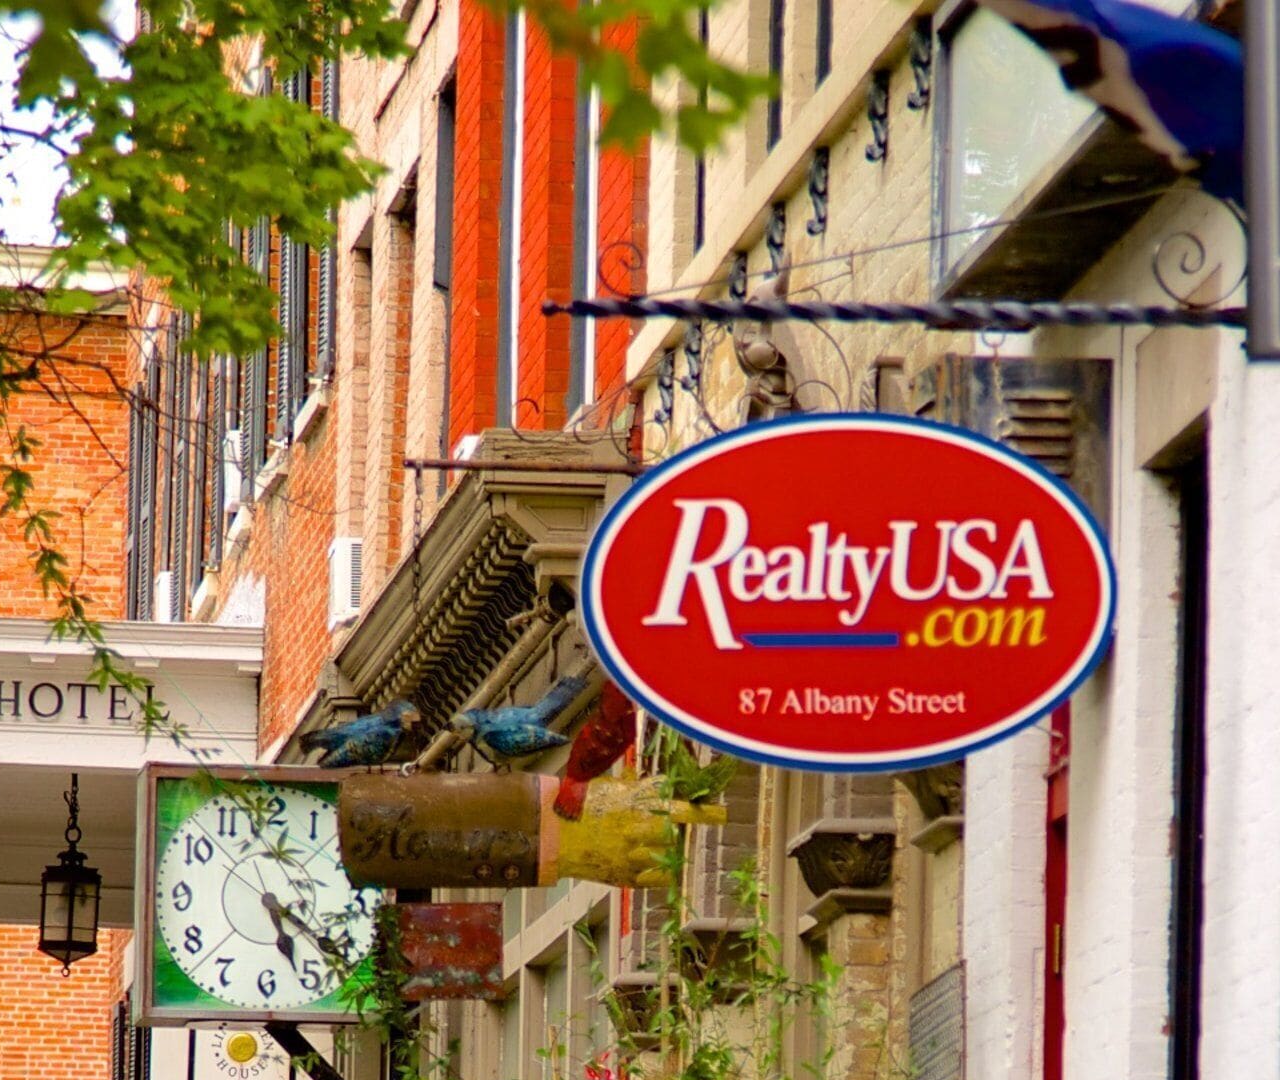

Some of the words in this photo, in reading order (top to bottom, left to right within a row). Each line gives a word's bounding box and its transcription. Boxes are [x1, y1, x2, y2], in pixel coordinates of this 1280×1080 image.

[641, 498, 1054, 650] RealtyUSA
[906, 605, 1047, 648] .com
[738, 688, 772, 715] 87
[780, 687, 879, 721] Albany
[888, 687, 967, 715] Street
[217, 805, 237, 838] 11
[184, 833, 214, 866] 10
[172, 880, 193, 912] 9
[183, 924, 204, 955] 8
[214, 957, 236, 988] 7
[257, 969, 276, 999] 6
[299, 958, 322, 991] 5
[216, 1058, 269, 1079] HOUSE
